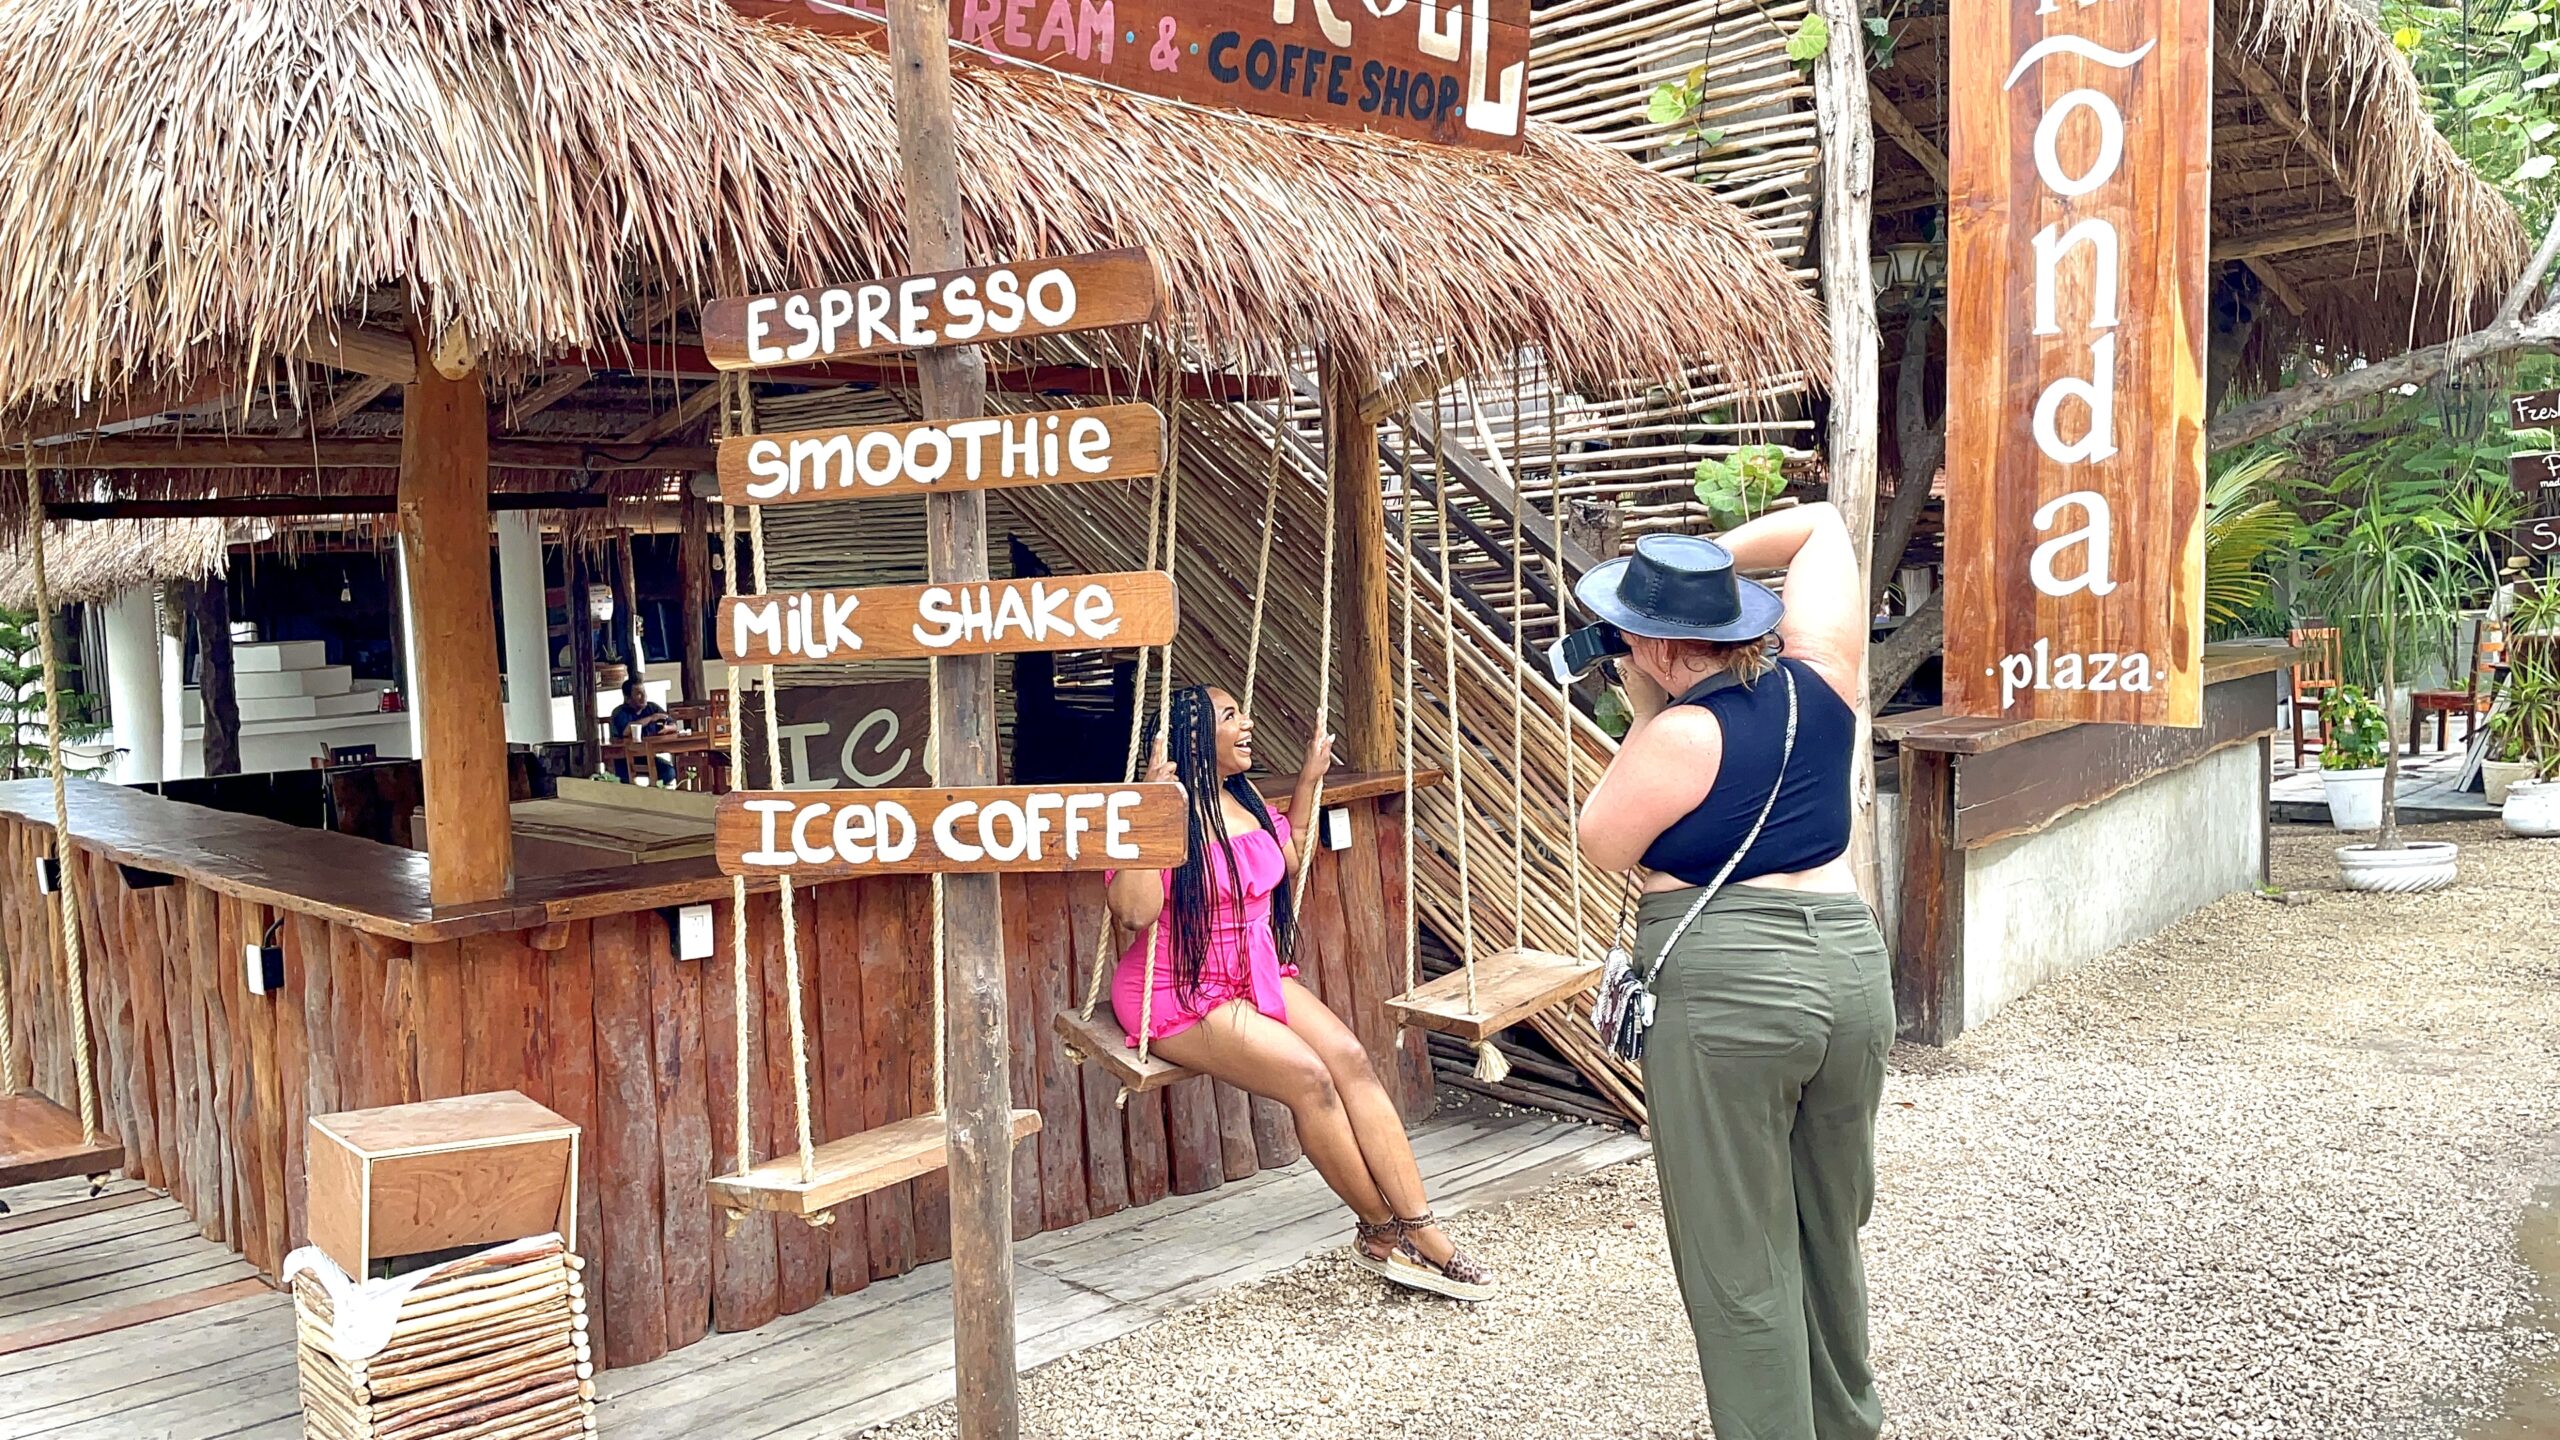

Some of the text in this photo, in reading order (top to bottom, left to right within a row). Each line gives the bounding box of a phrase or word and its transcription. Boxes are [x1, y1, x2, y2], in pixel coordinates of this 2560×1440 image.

[950, 0, 1460, 123] REAM & COFFE SHOP
[747, 268, 1077, 364] ESPRESSO
[746, 415, 1112, 499] SmOOTHie
[733, 581, 1122, 659] MiLK SHAKe
[778, 708, 937, 789] IC
[741, 790, 1143, 866] ICeD COFFE
